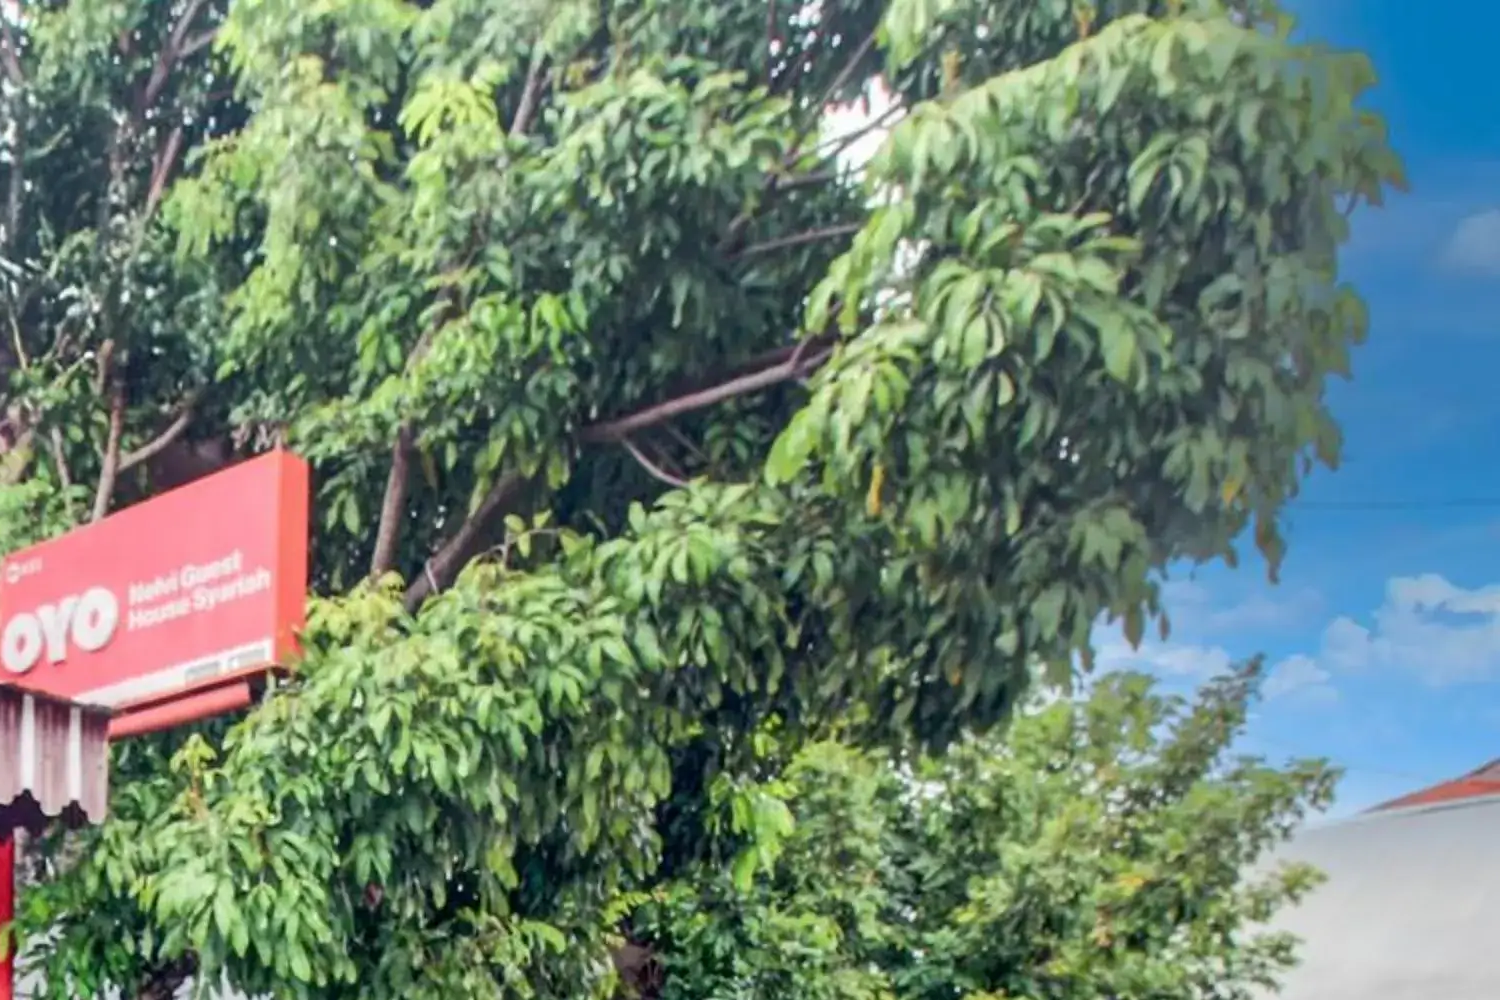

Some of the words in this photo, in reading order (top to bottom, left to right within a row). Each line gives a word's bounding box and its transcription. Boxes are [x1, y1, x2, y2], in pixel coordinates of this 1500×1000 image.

[128, 597, 191, 632] House
[192, 565, 271, 611] Syariah
[180, 548, 243, 589] Guest
[1, 586, 119, 674] OYO
